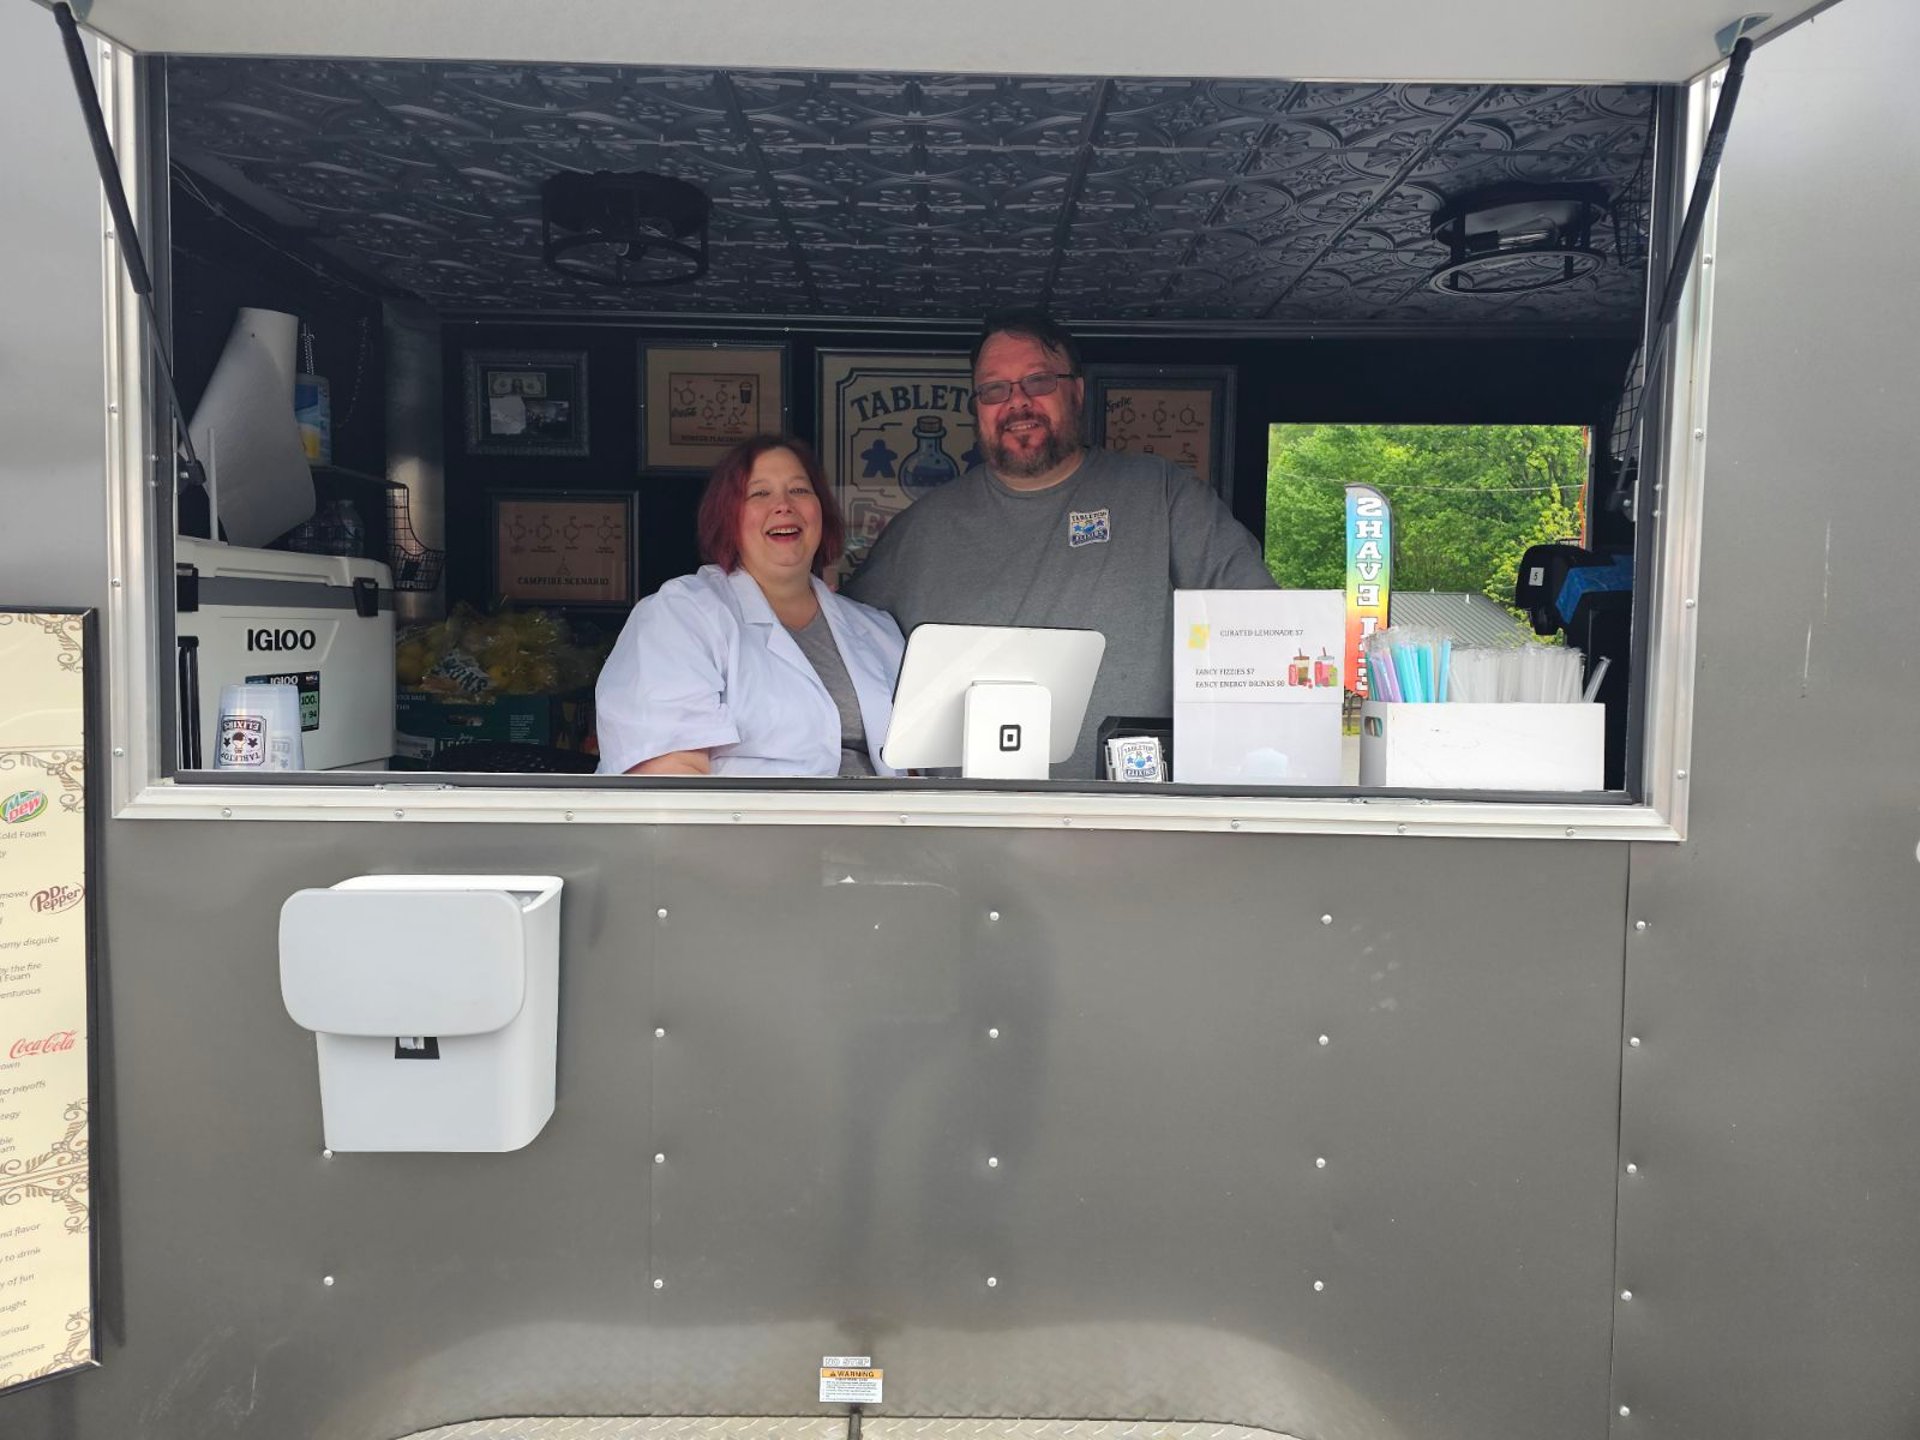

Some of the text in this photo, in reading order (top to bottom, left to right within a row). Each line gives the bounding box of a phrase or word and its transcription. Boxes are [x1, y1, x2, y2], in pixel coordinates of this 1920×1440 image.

[517, 576, 609, 586] CAMPFIRE SCENARIO
[1533, 571, 1539, 582] 5
[1220, 629, 1252, 637] CURATED
[1254, 629, 1293, 637] LEMONADE
[247, 628, 316, 651] IGLOO
[1195, 668, 1217, 676] FANCY
[270, 675, 298, 685] IGLOO
[1219, 680, 1247, 688] ENERGY
[19, 830, 47, 838] Foam
[49, 886, 69, 898] Dr
[37, 890, 81, 912] Pepper
[23, 936, 59, 946] disguise
[11, 965, 26, 973] the
[27, 962, 42, 971] fire
[4, 973, 30, 982] Foam
[12, 1080, 46, 1094] payoffs
[15, 1223, 41, 1236] flavor
[5, 1254, 15, 1262] to
[17, 1247, 41, 1259] drink
[19, 1273, 35, 1283] fun
